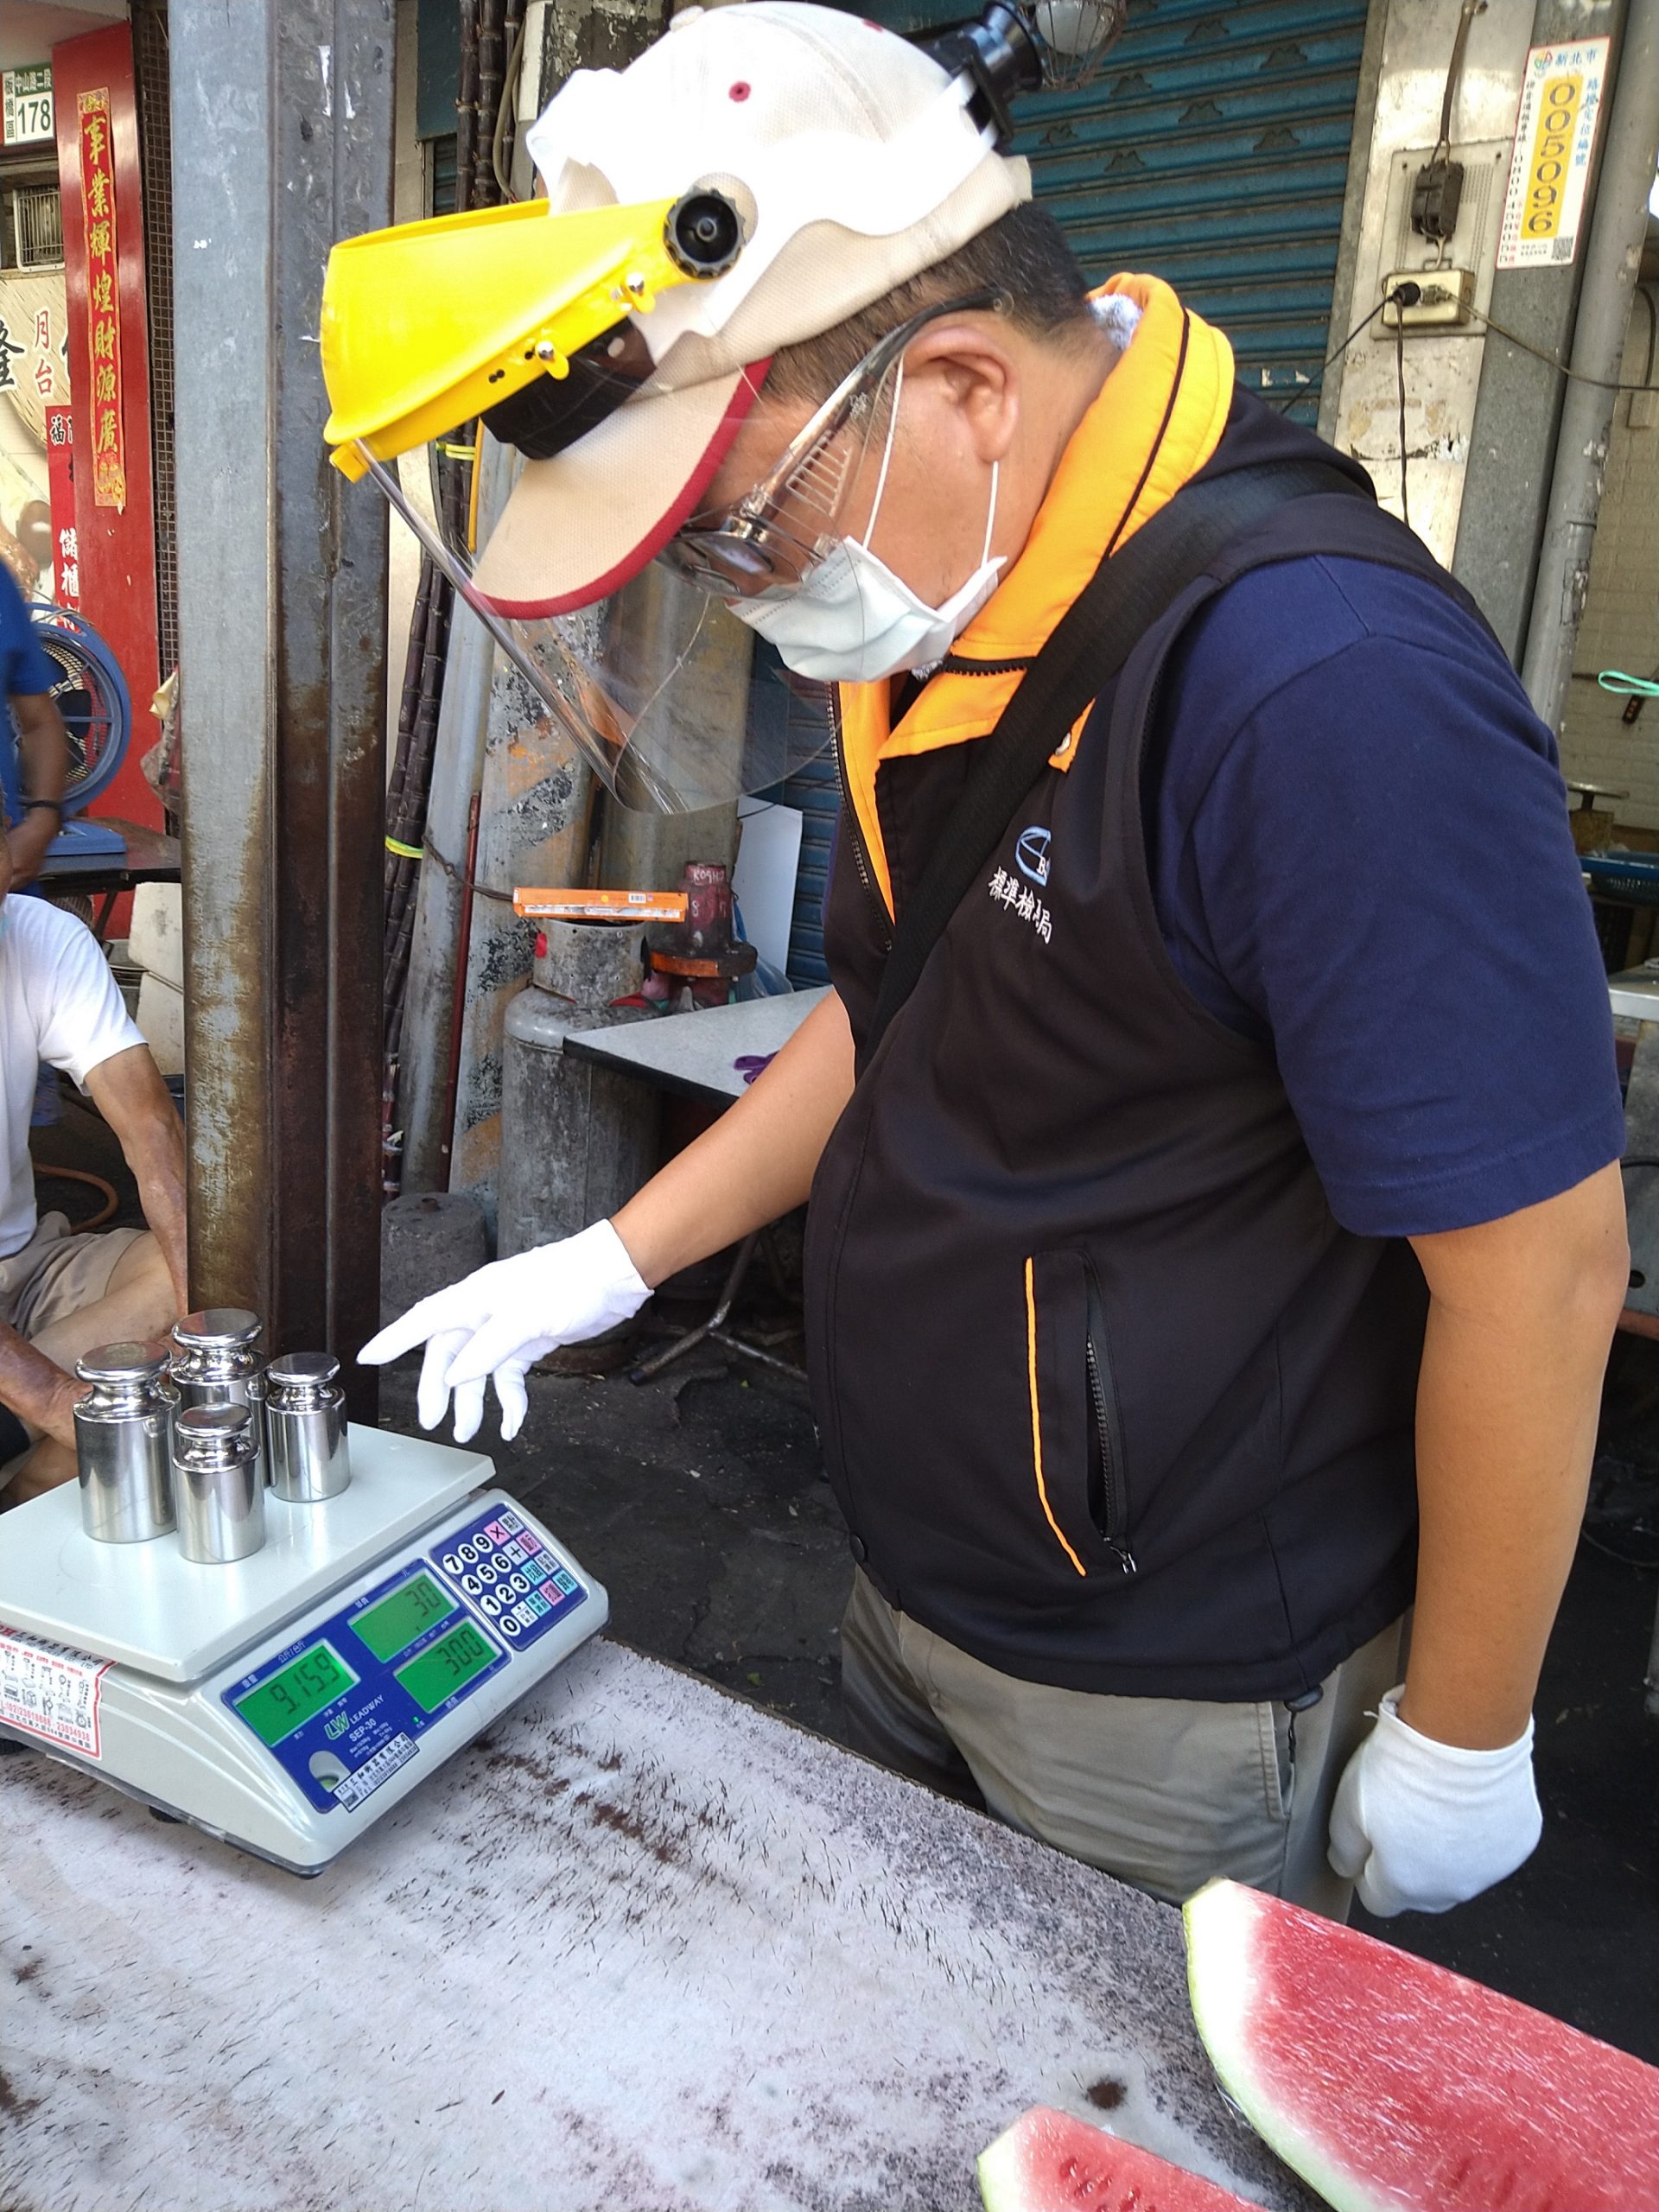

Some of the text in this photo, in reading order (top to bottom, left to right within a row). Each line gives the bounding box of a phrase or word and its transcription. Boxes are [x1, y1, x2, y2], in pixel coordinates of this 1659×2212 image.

[1555, 48, 1596, 66] 新北市
[16, 68, 52, 94] 中山路二段
[5, 78, 15, 138] 板橋區
[18, 99, 51, 134] 178
[1528, 82, 1575, 233] 005096
[35, 310, 53, 394] 月台
[445, 1557, 460, 1571] 7
[461, 1547, 475, 1560] 8
[476, 1536, 490, 1549] 9
[467, 1578, 480, 1592] 4
[480, 1567, 494, 1580] 5
[495, 1556, 509, 1569] 6
[405, 1581, 441, 1617] 30
[486, 1576, 528, 1611] 1 2 3
[503, 1619, 518, 1633] 0
[437, 1629, 484, 1676] 300
[324, 1694, 385, 1740] LW LEADWAY
[349, 1718, 377, 1742] SEP-30
